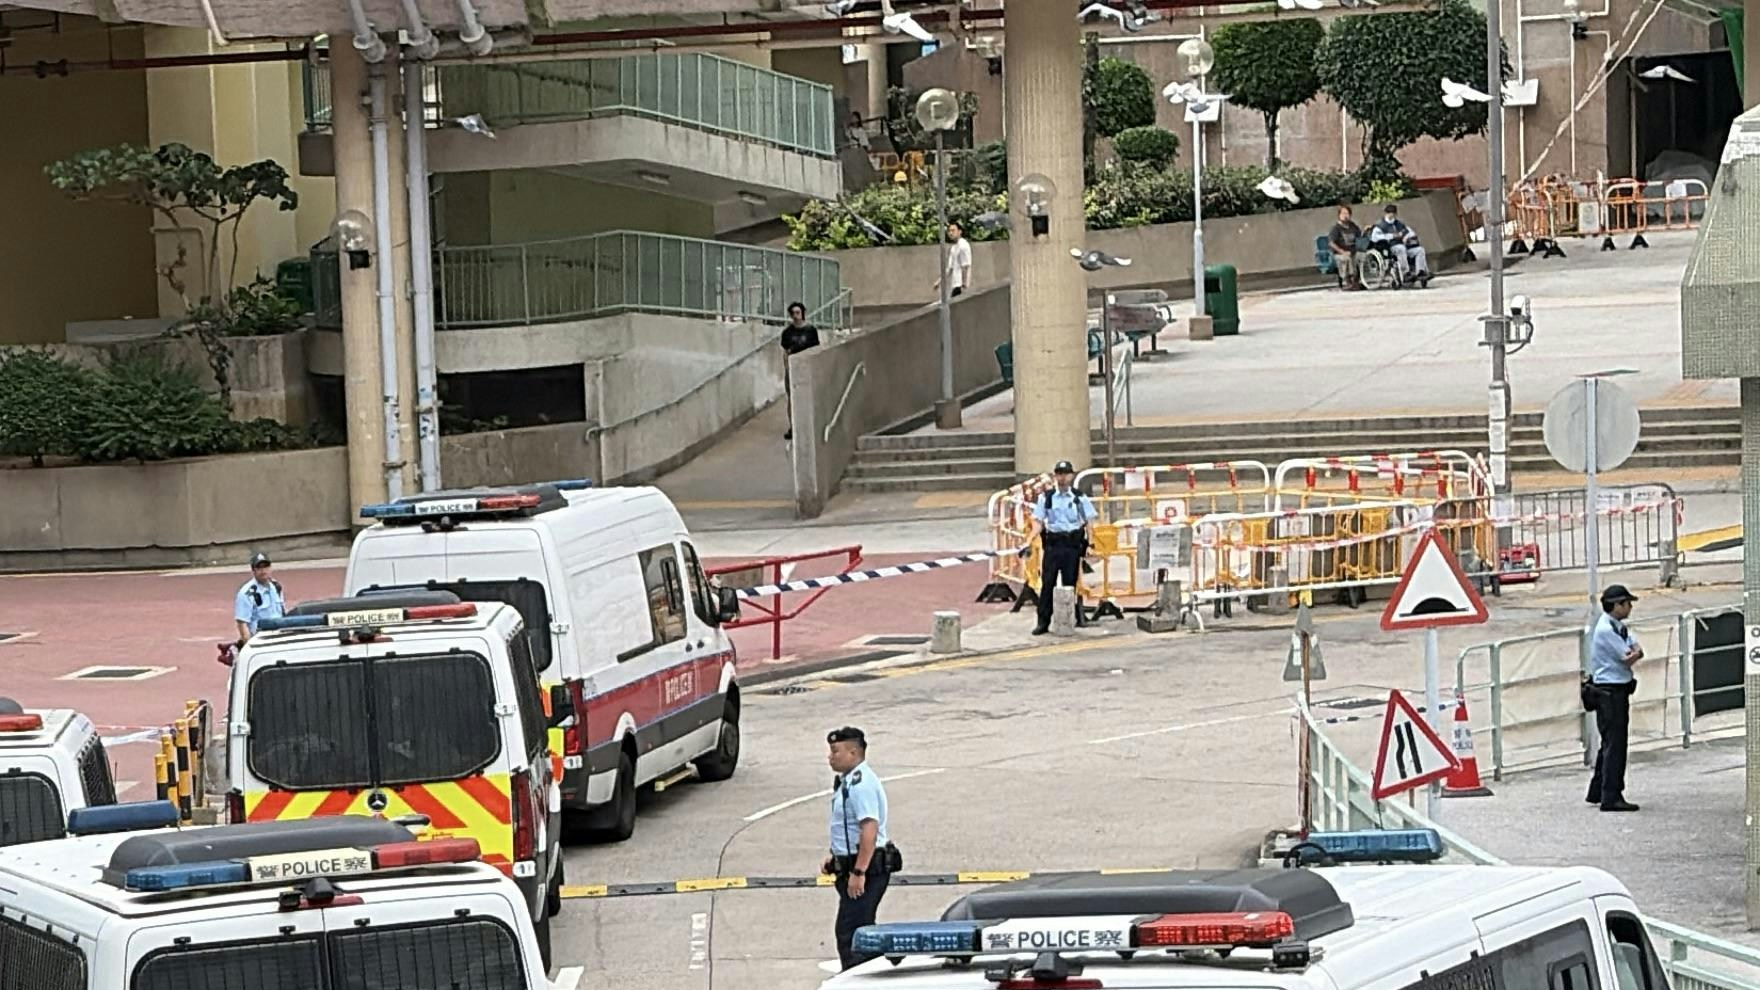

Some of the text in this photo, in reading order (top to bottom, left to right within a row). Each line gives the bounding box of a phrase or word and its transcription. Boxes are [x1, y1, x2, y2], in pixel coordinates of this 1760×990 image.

[347, 613, 385, 624] POLICE
[282, 858, 341, 876] POLICE
[1018, 930, 1090, 947] POLICE
